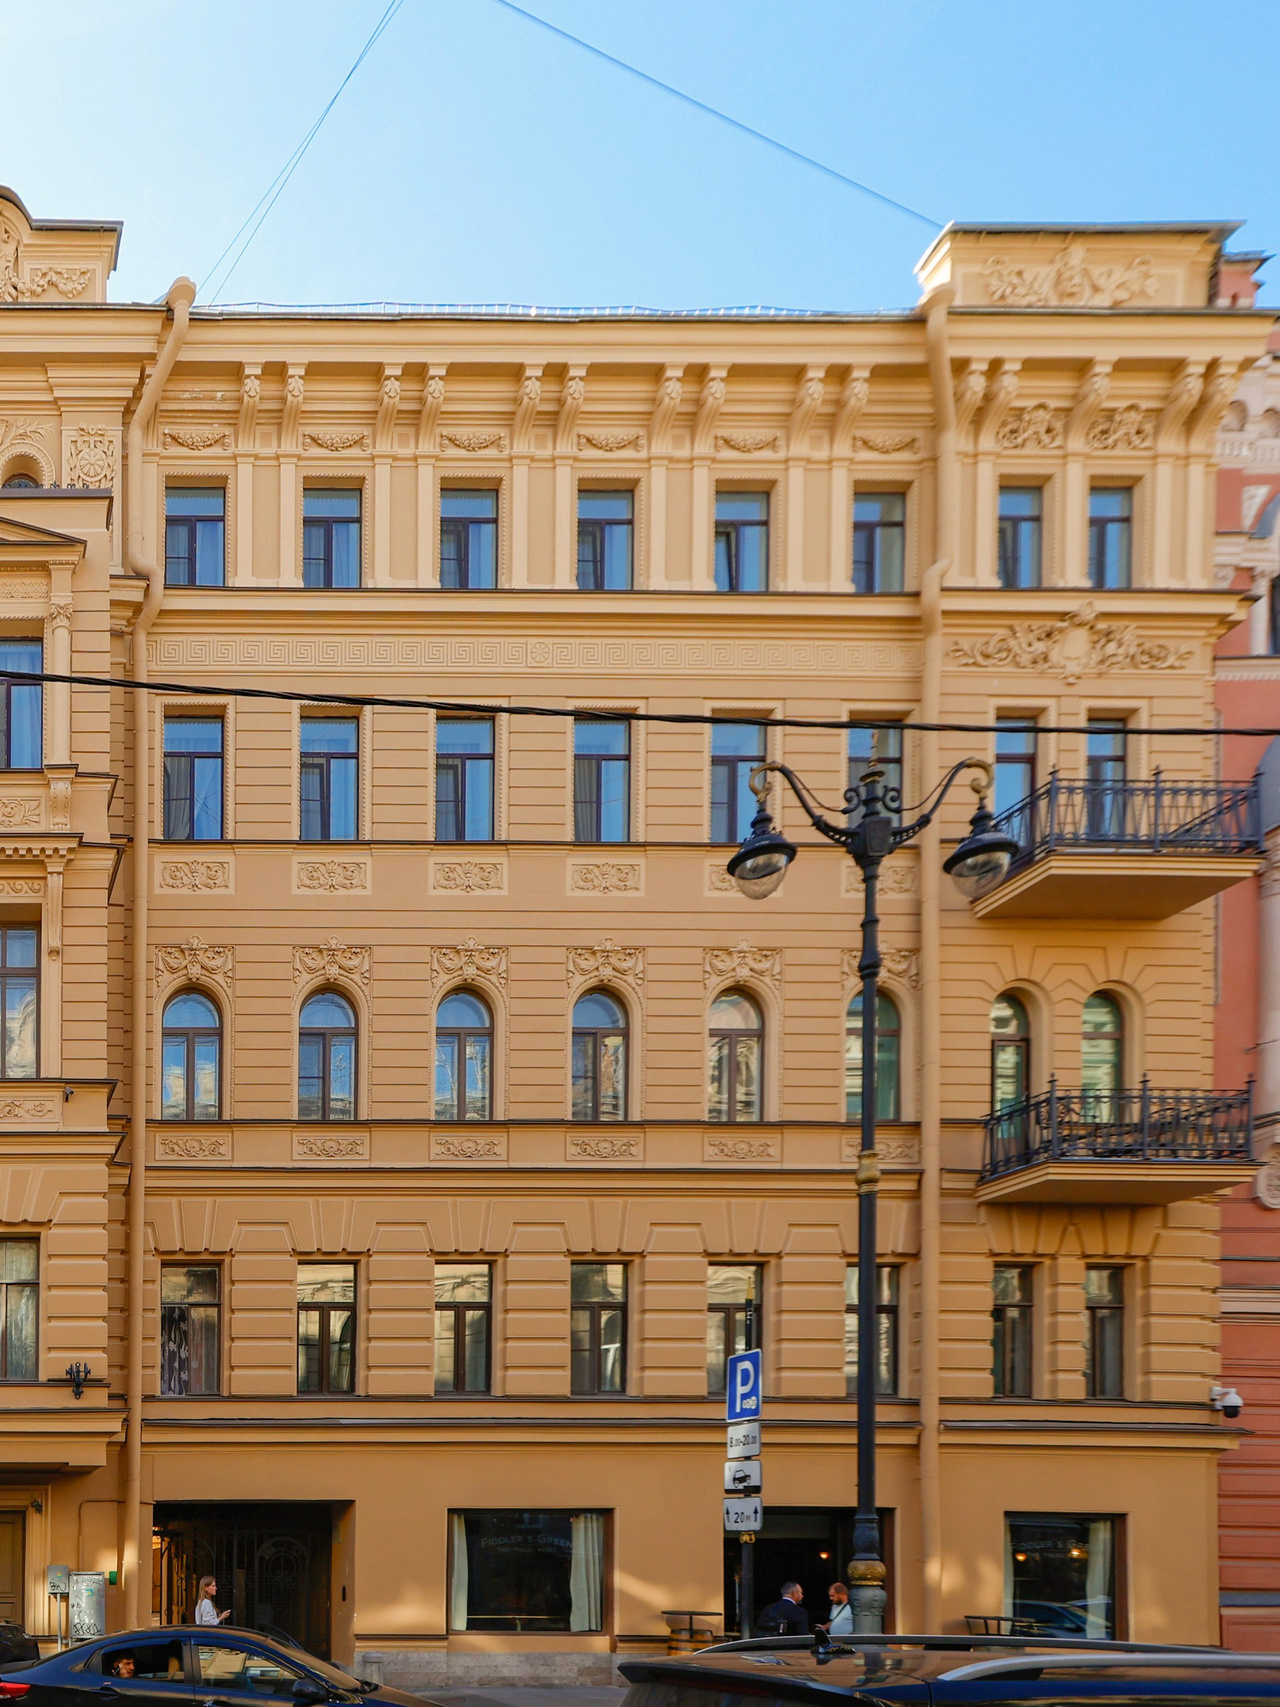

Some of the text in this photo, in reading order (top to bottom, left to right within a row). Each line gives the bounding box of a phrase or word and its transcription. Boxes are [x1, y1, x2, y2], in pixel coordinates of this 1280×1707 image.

[735, 1360, 755, 1413] P
[734, 1511, 745, 1524] 20
[480, 1535, 534, 1548] FIDDLERS
